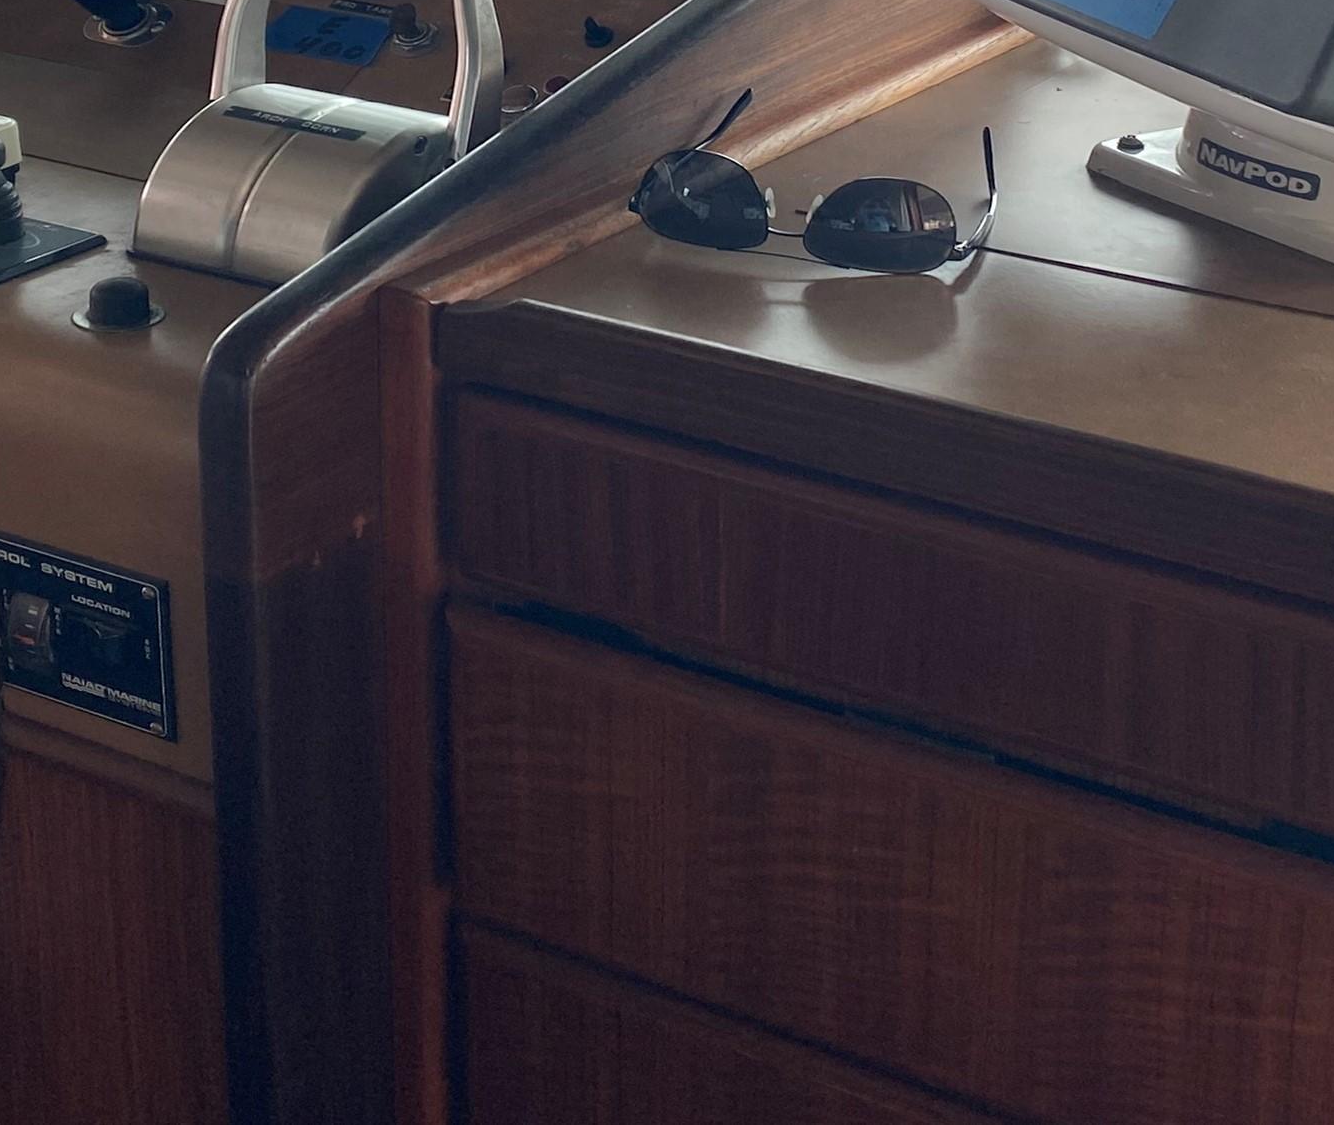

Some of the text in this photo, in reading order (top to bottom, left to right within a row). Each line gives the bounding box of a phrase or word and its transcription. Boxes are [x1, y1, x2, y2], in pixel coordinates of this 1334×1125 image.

[1200, 144, 1312, 194] NAVPOD
[39, 562, 113, 595] SYSTEM
[70, 594, 132, 620] LOCATION
[107, 686, 162, 712] MARINE
